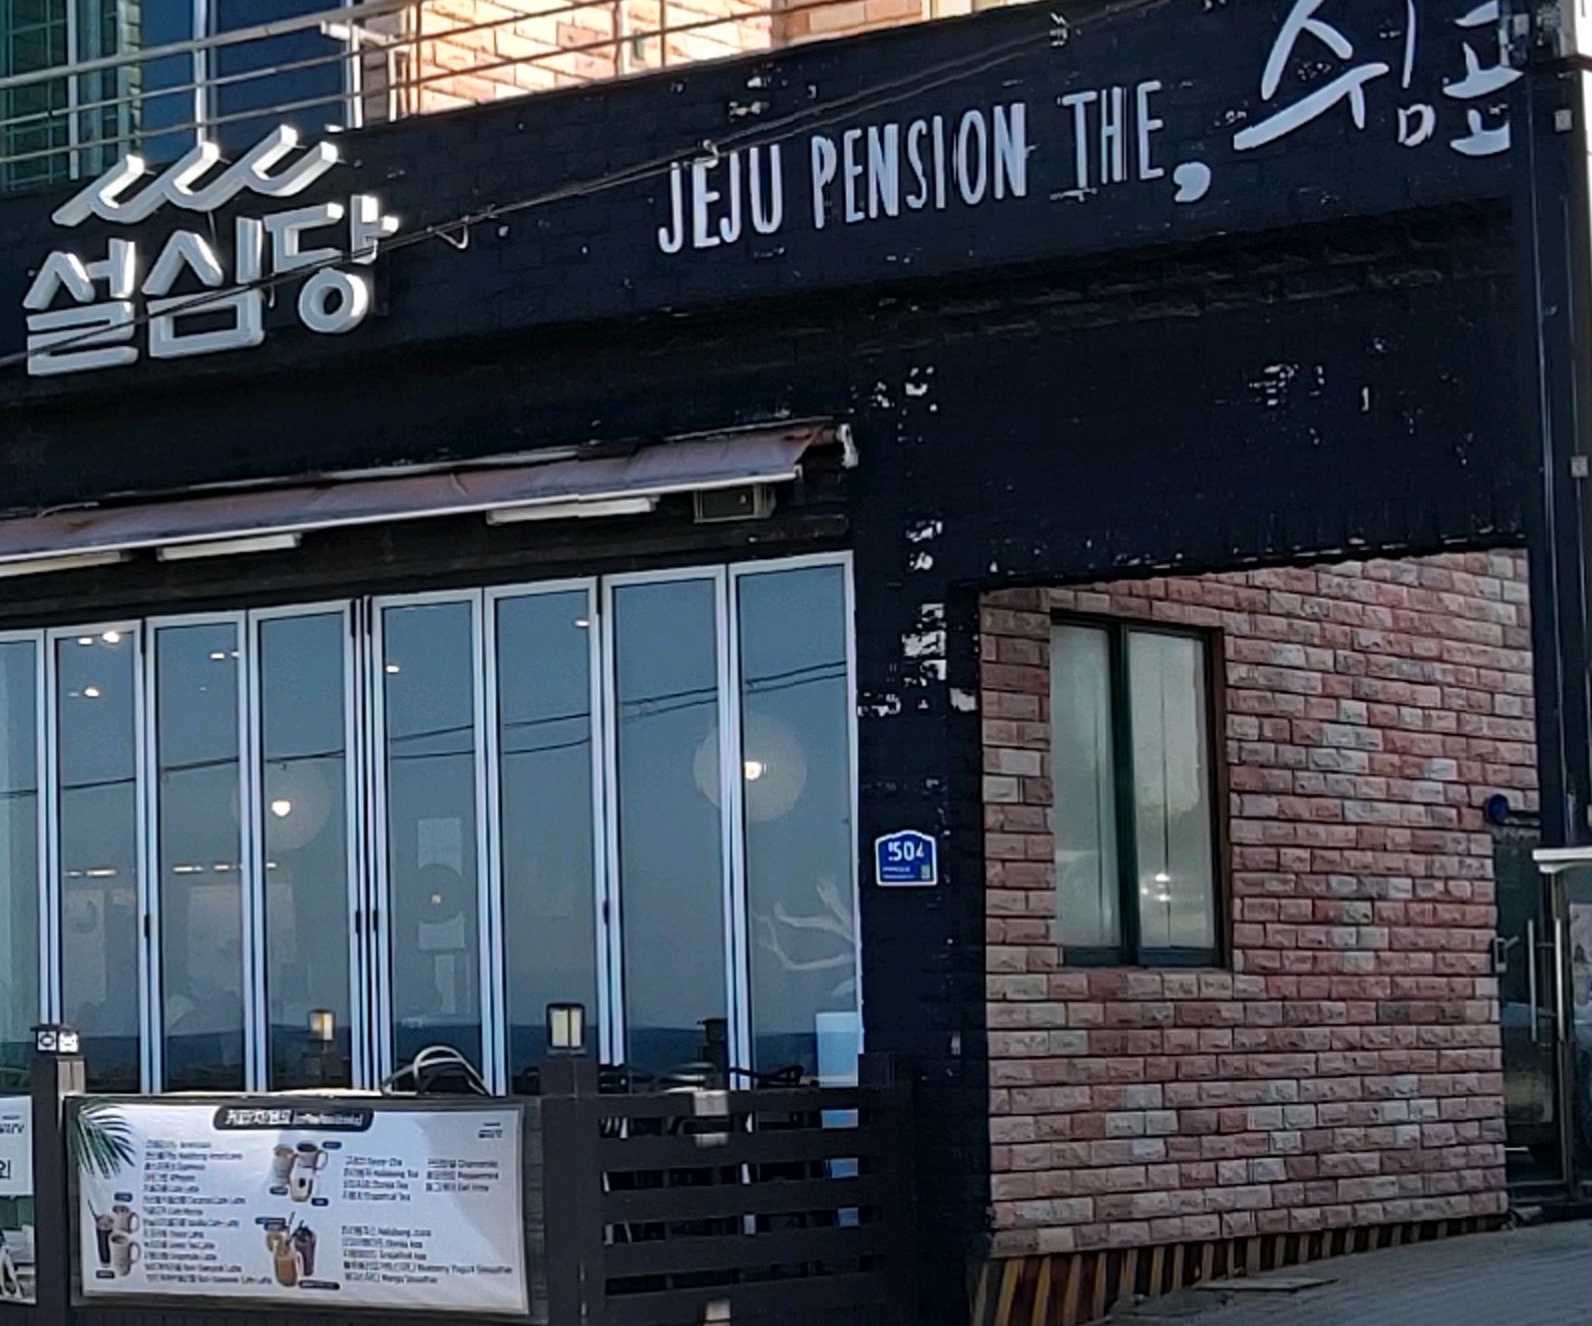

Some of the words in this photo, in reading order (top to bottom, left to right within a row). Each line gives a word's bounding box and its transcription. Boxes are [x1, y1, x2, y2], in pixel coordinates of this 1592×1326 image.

[657, 143, 784, 255] JEJU
[810, 104, 1028, 229] PENSION
[22, 194, 400, 377] 설심당
